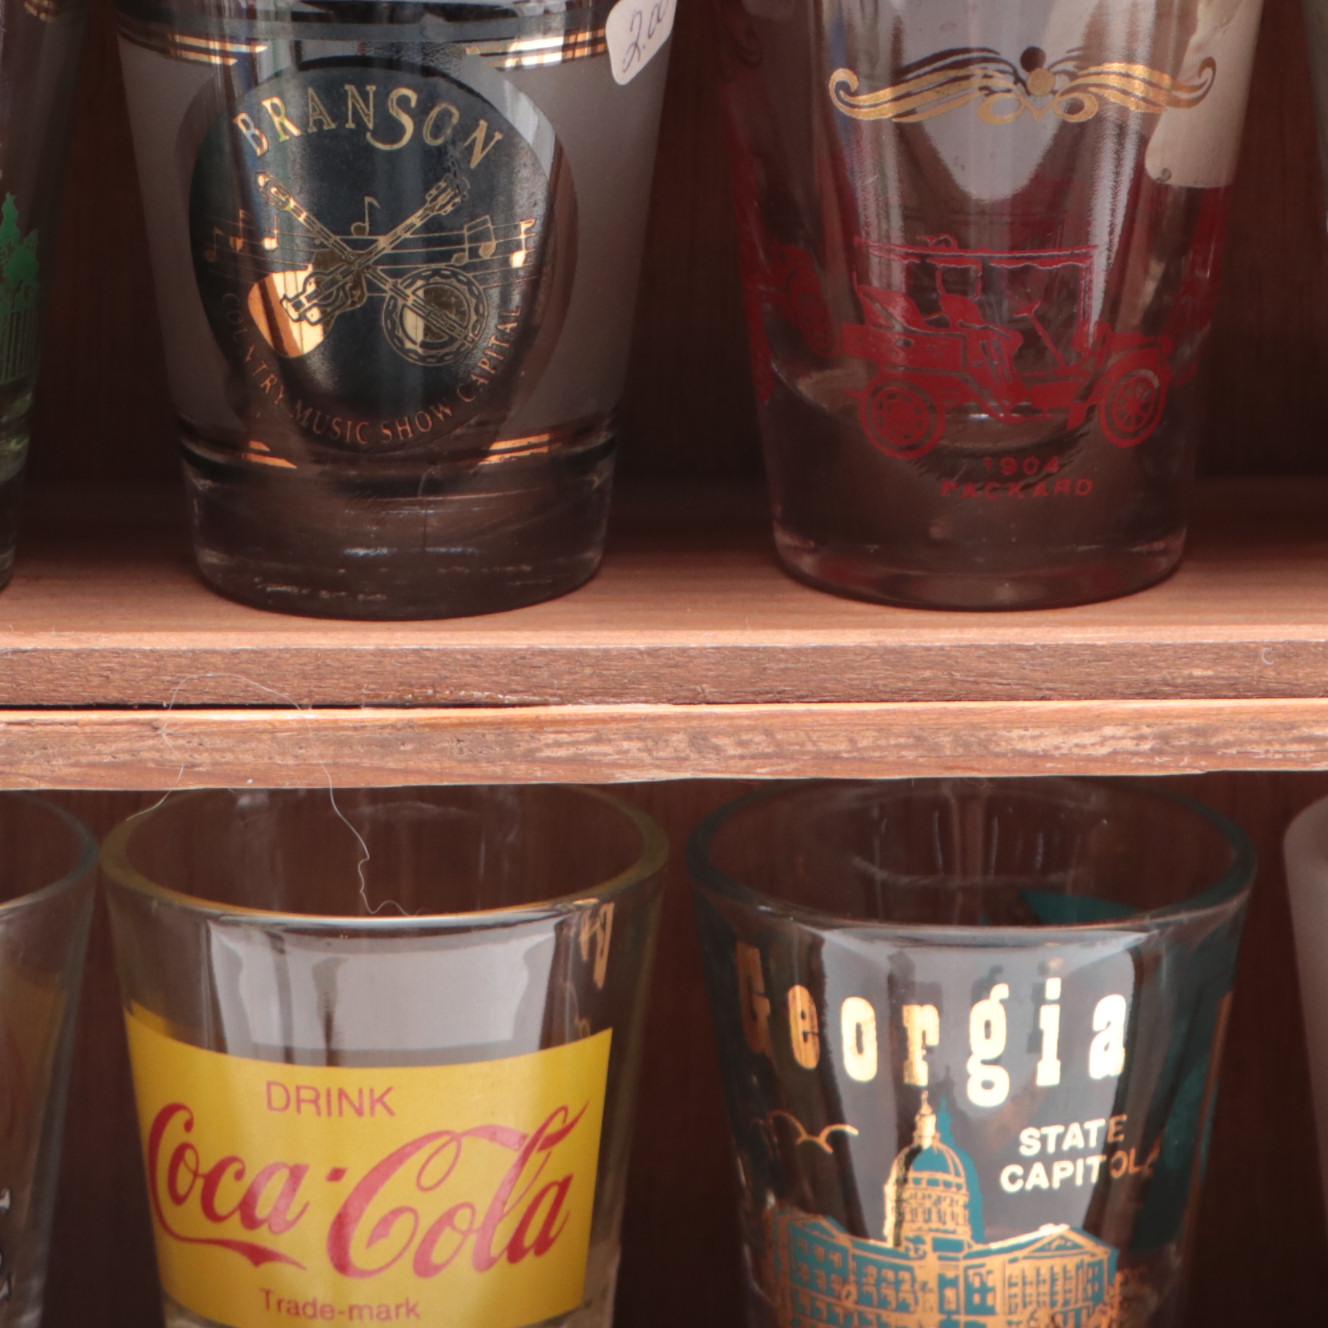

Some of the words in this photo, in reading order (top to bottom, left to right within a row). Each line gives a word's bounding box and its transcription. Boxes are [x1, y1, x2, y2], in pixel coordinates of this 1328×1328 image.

[233, 83, 504, 172] BRANSON
[290, 398, 370, 446] MUSIC
[379, 404, 454, 446] SHOW
[736, 940, 1129, 1108] Georgia
[265, 1080, 398, 1119] DRINK
[1018, 1114, 1128, 1156] STATE
[999, 1149, 1142, 1194] CAPITOL
[259, 1287, 421, 1322] Trade-mark
